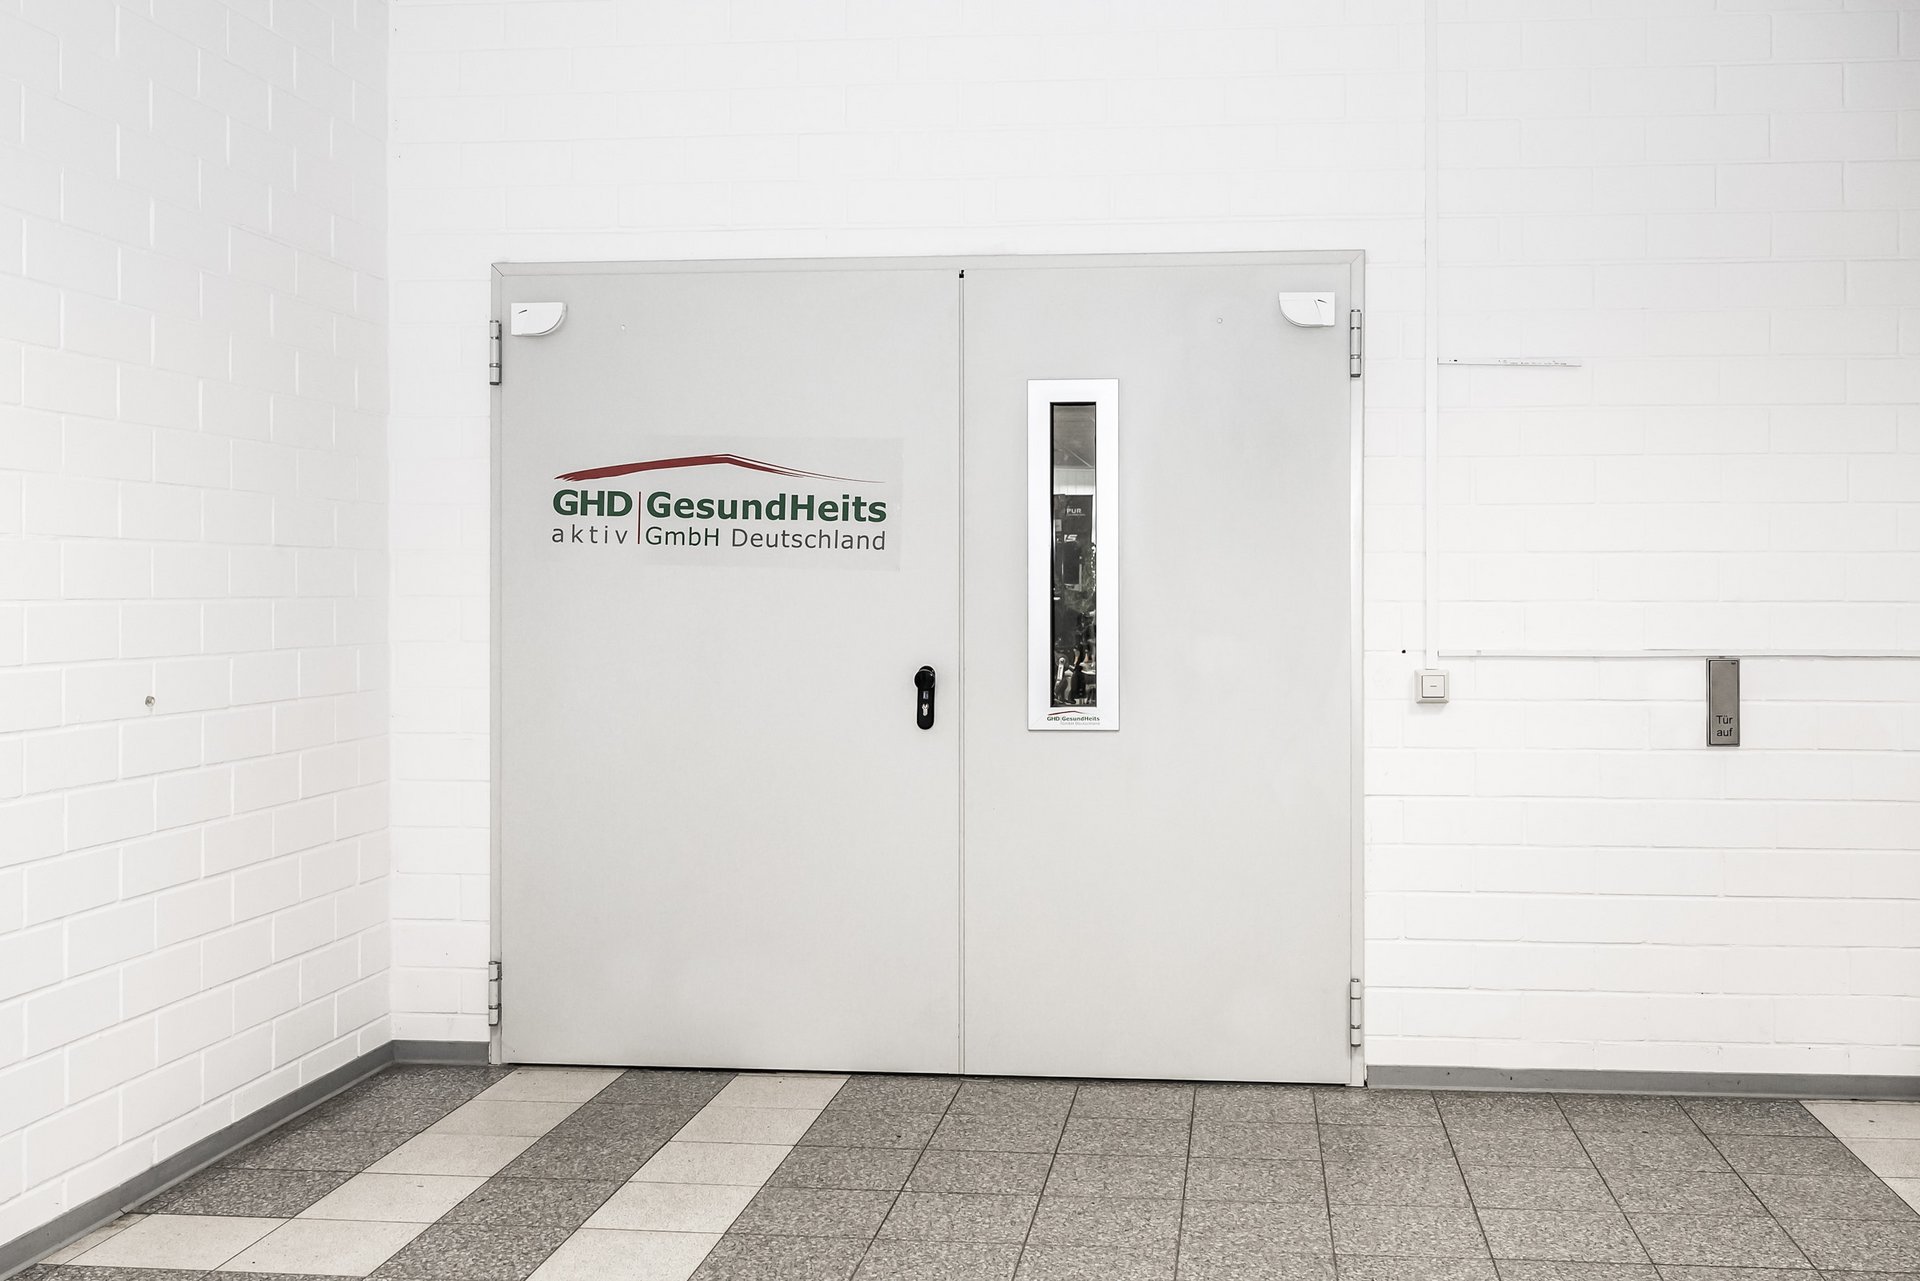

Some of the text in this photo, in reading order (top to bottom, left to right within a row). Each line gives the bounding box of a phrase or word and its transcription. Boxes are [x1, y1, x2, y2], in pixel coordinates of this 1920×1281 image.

[552, 489, 887, 523] GHD GesundHeits
[552, 523, 886, 551] aktiv GmbH Deutschland
[1715, 714, 1734, 725] Tür
[1716, 727, 1734, 737] auf
